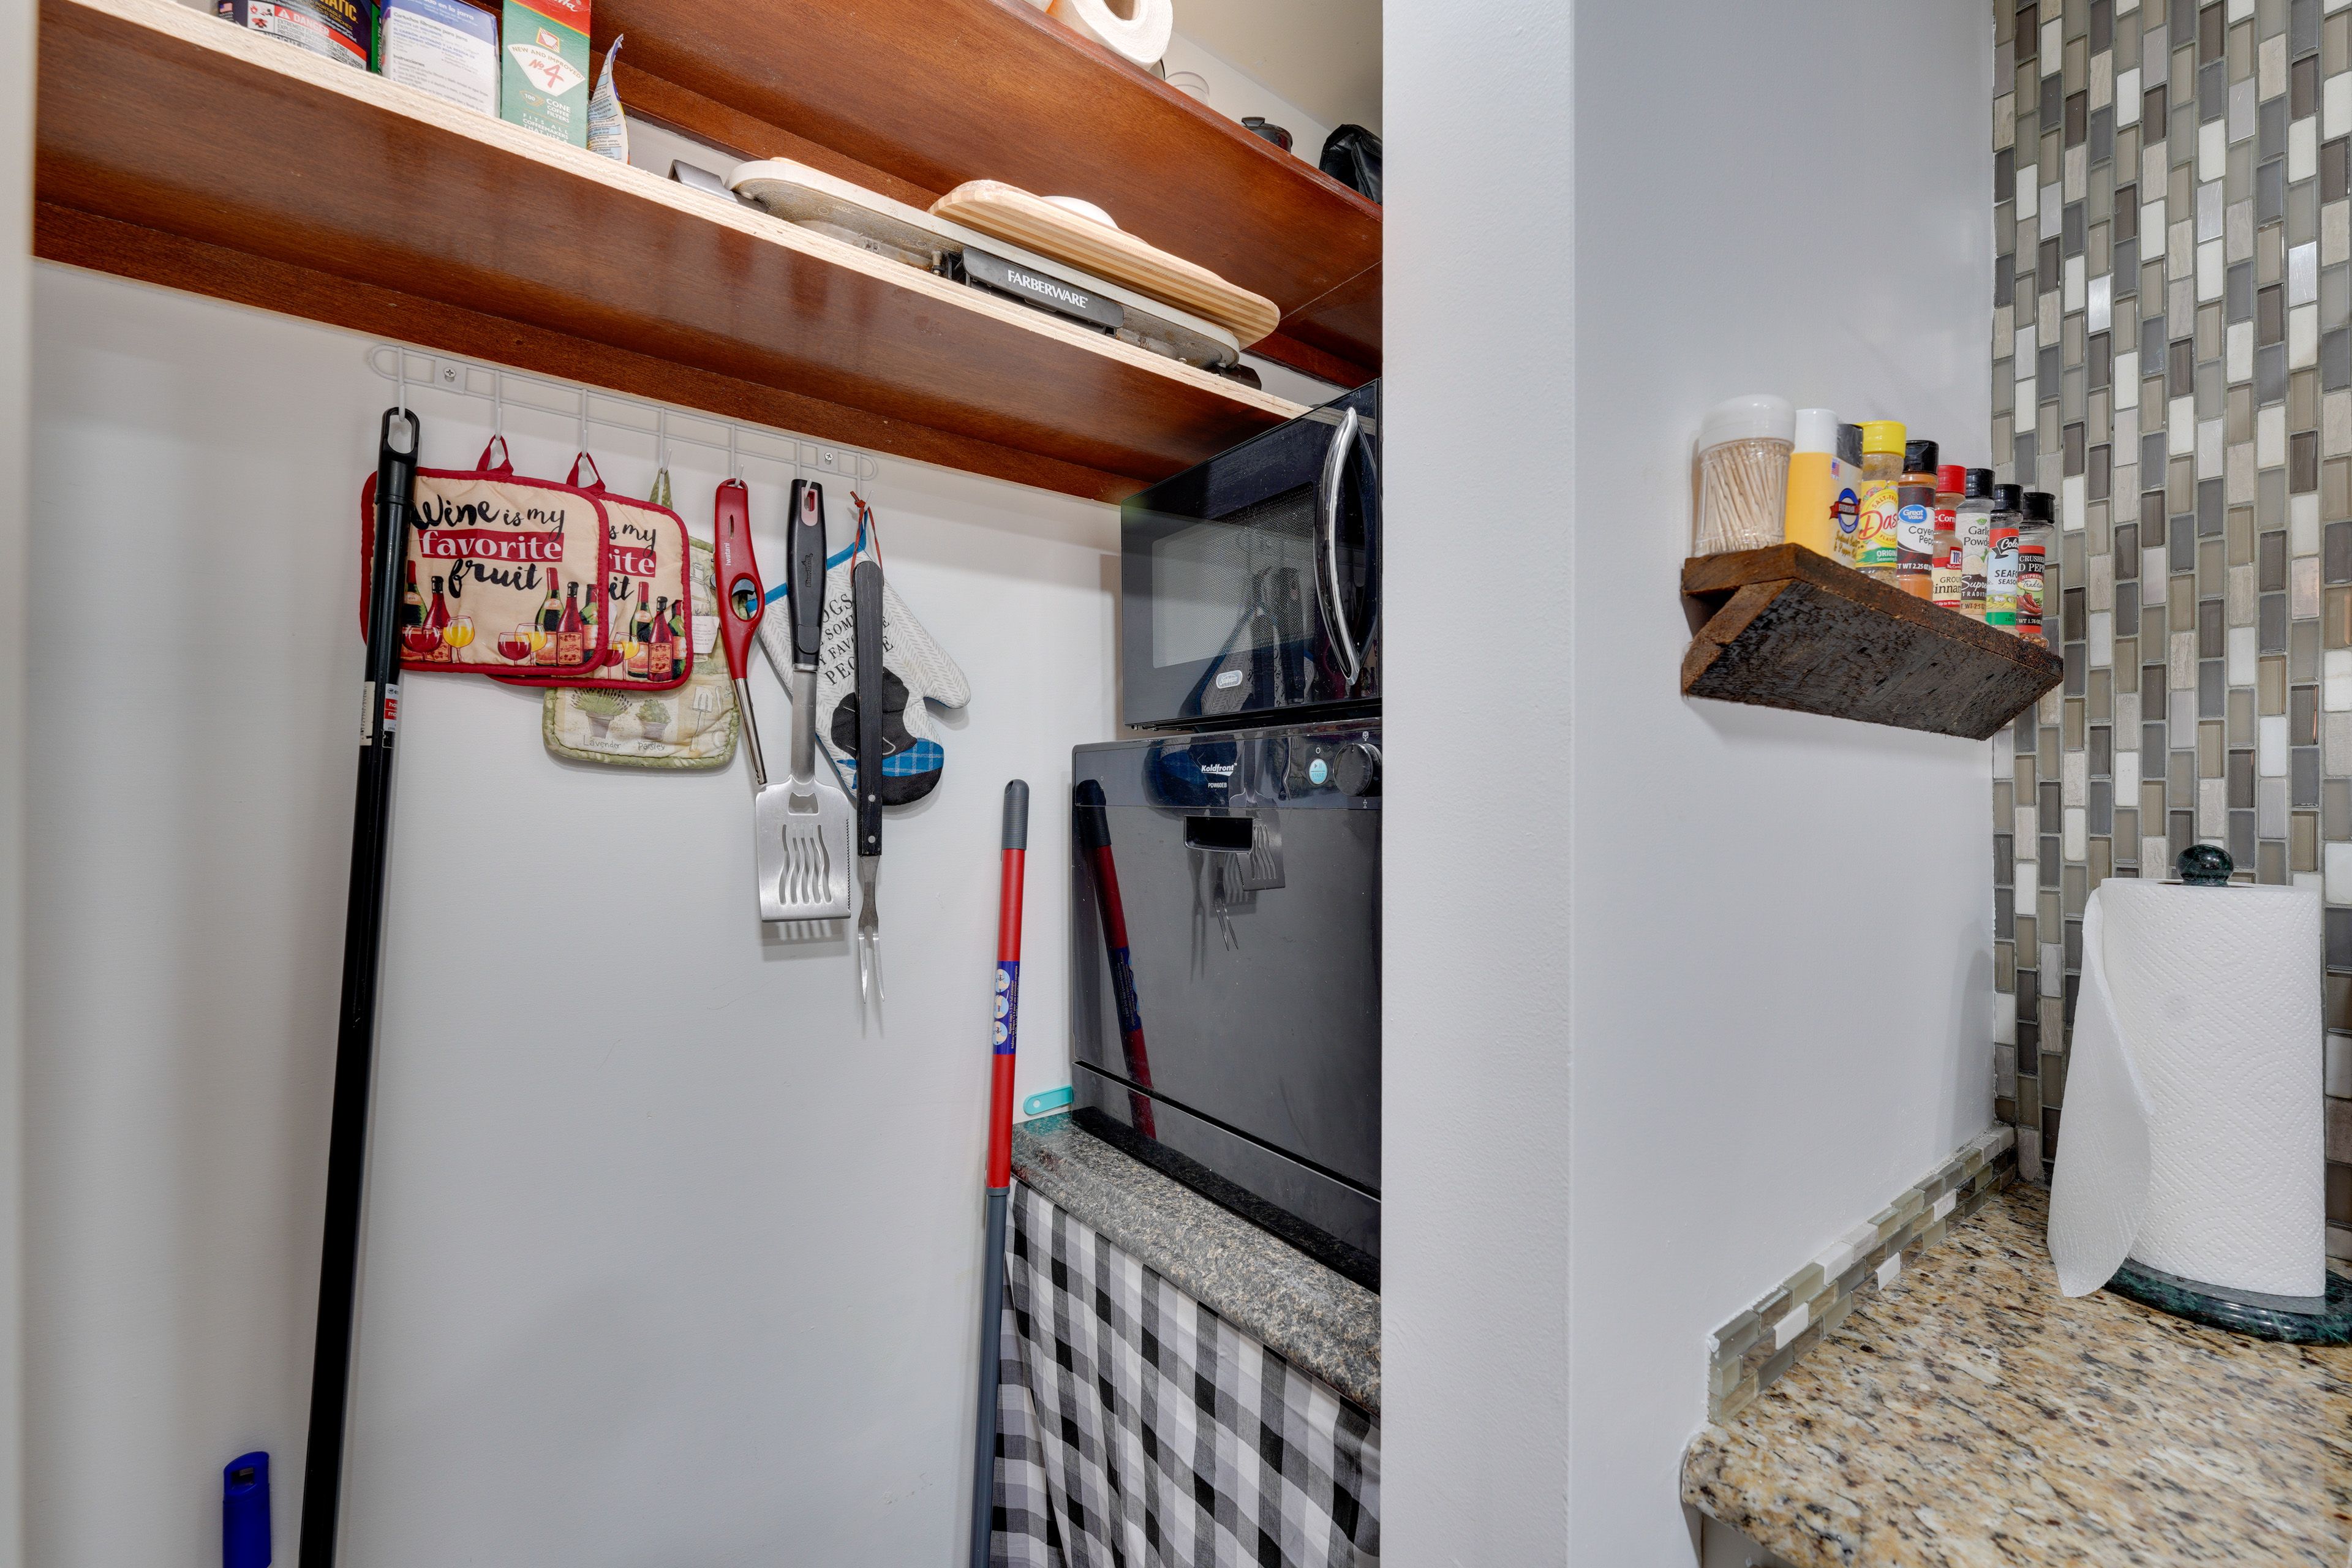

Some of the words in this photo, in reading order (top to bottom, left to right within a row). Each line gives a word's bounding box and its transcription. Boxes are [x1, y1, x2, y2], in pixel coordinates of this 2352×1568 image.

[293, 12, 330, 37] DANGER
[530, 50, 546, 58] AND
[548, 55, 584, 80] IMPROVED!
[543, 64, 564, 88] 4
[546, 98, 571, 113] CONE
[547, 105, 570, 118] COFFEE
[547, 110, 570, 123] FILTERS
[523, 118, 569, 140] COFFEEMAKERS
[1008, 269, 1087, 308] FARBERWARE
[411, 494, 500, 530] Wine
[503, 509, 524, 527] is
[527, 508, 565, 542] my
[1858, 510, 1897, 540] Das
[419, 530, 562, 560] favorite
[609, 525, 620, 540] s
[622, 524, 657, 559] my
[2000, 537, 2019, 551] Colo
[448, 558, 543, 598] fruit
[822, 594, 853, 623] OGS
[824, 614, 853, 641] SOM
[583, 735, 622, 749] Lavender
[1201, 764, 1234, 774] Koldfront
